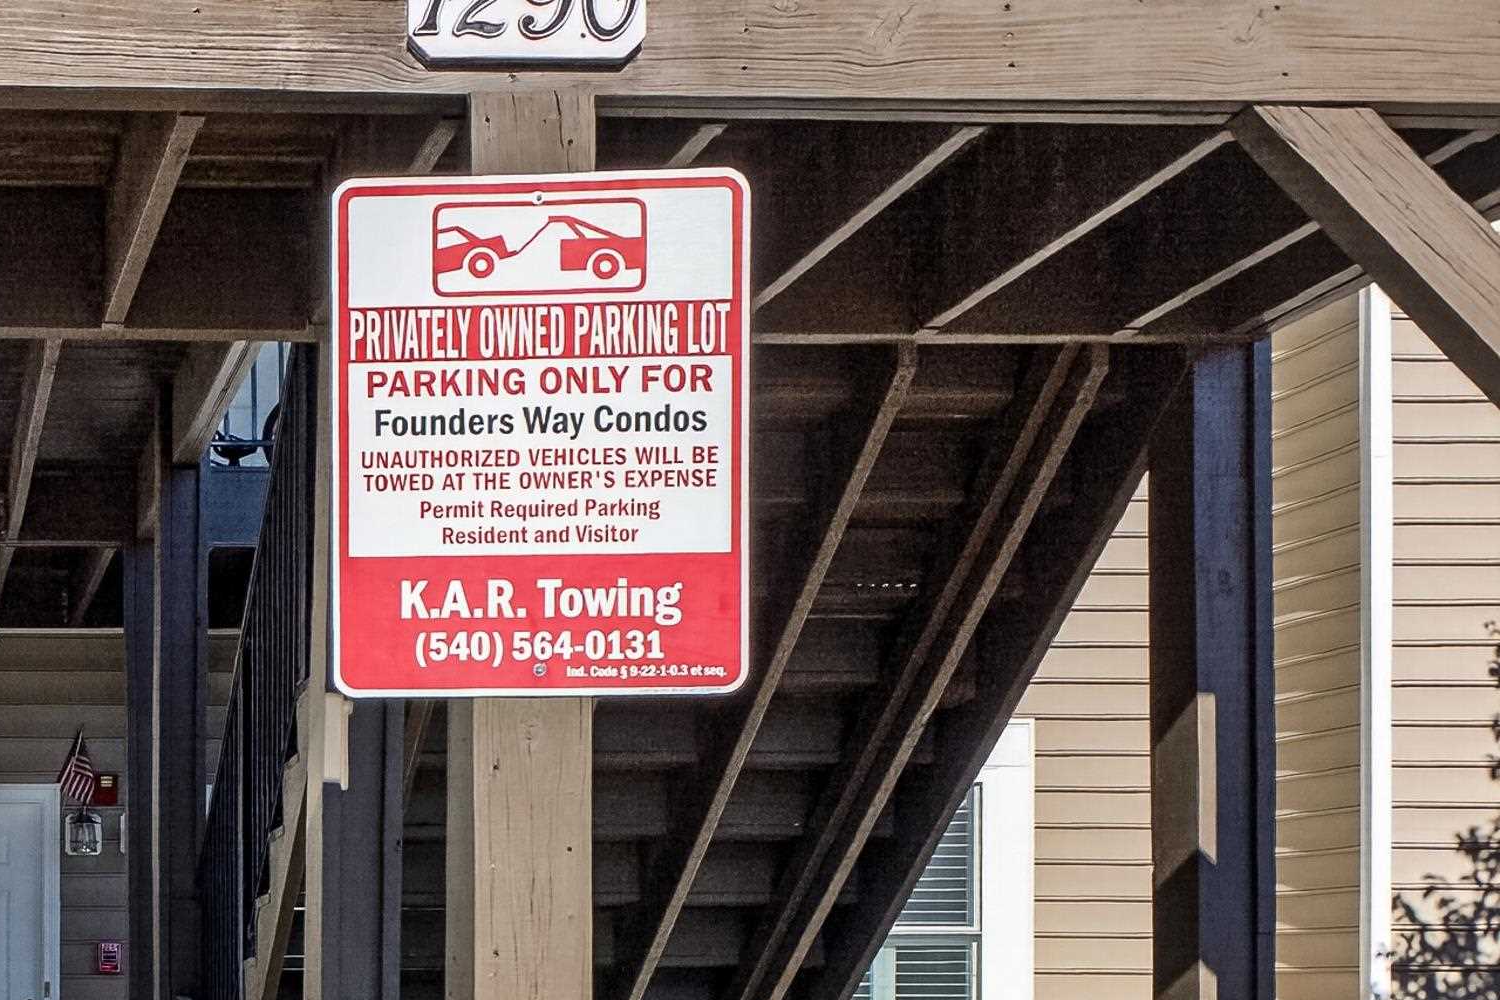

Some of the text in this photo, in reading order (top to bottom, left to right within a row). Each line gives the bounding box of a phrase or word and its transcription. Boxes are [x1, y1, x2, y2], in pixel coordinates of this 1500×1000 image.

[350, 301, 731, 361] PRIVATELY OWNED PARKING LOT
[367, 363, 713, 398] PARKING ONLY FOR
[375, 403, 708, 440] Founders Way Condos
[361, 445, 719, 469] UNAUTHORIZED VEHICLES WILL BE
[363, 468, 717, 492] TOWED AT THE OWNER'S EXPENSE
[419, 498, 661, 521] Permit Required Parking
[442, 525, 640, 545] Resident and Visitor
[400, 576, 684, 626] K.A.R. Towing
[414, 628, 665, 669] (540) 564-0131
[590, 665, 618, 678] Code
